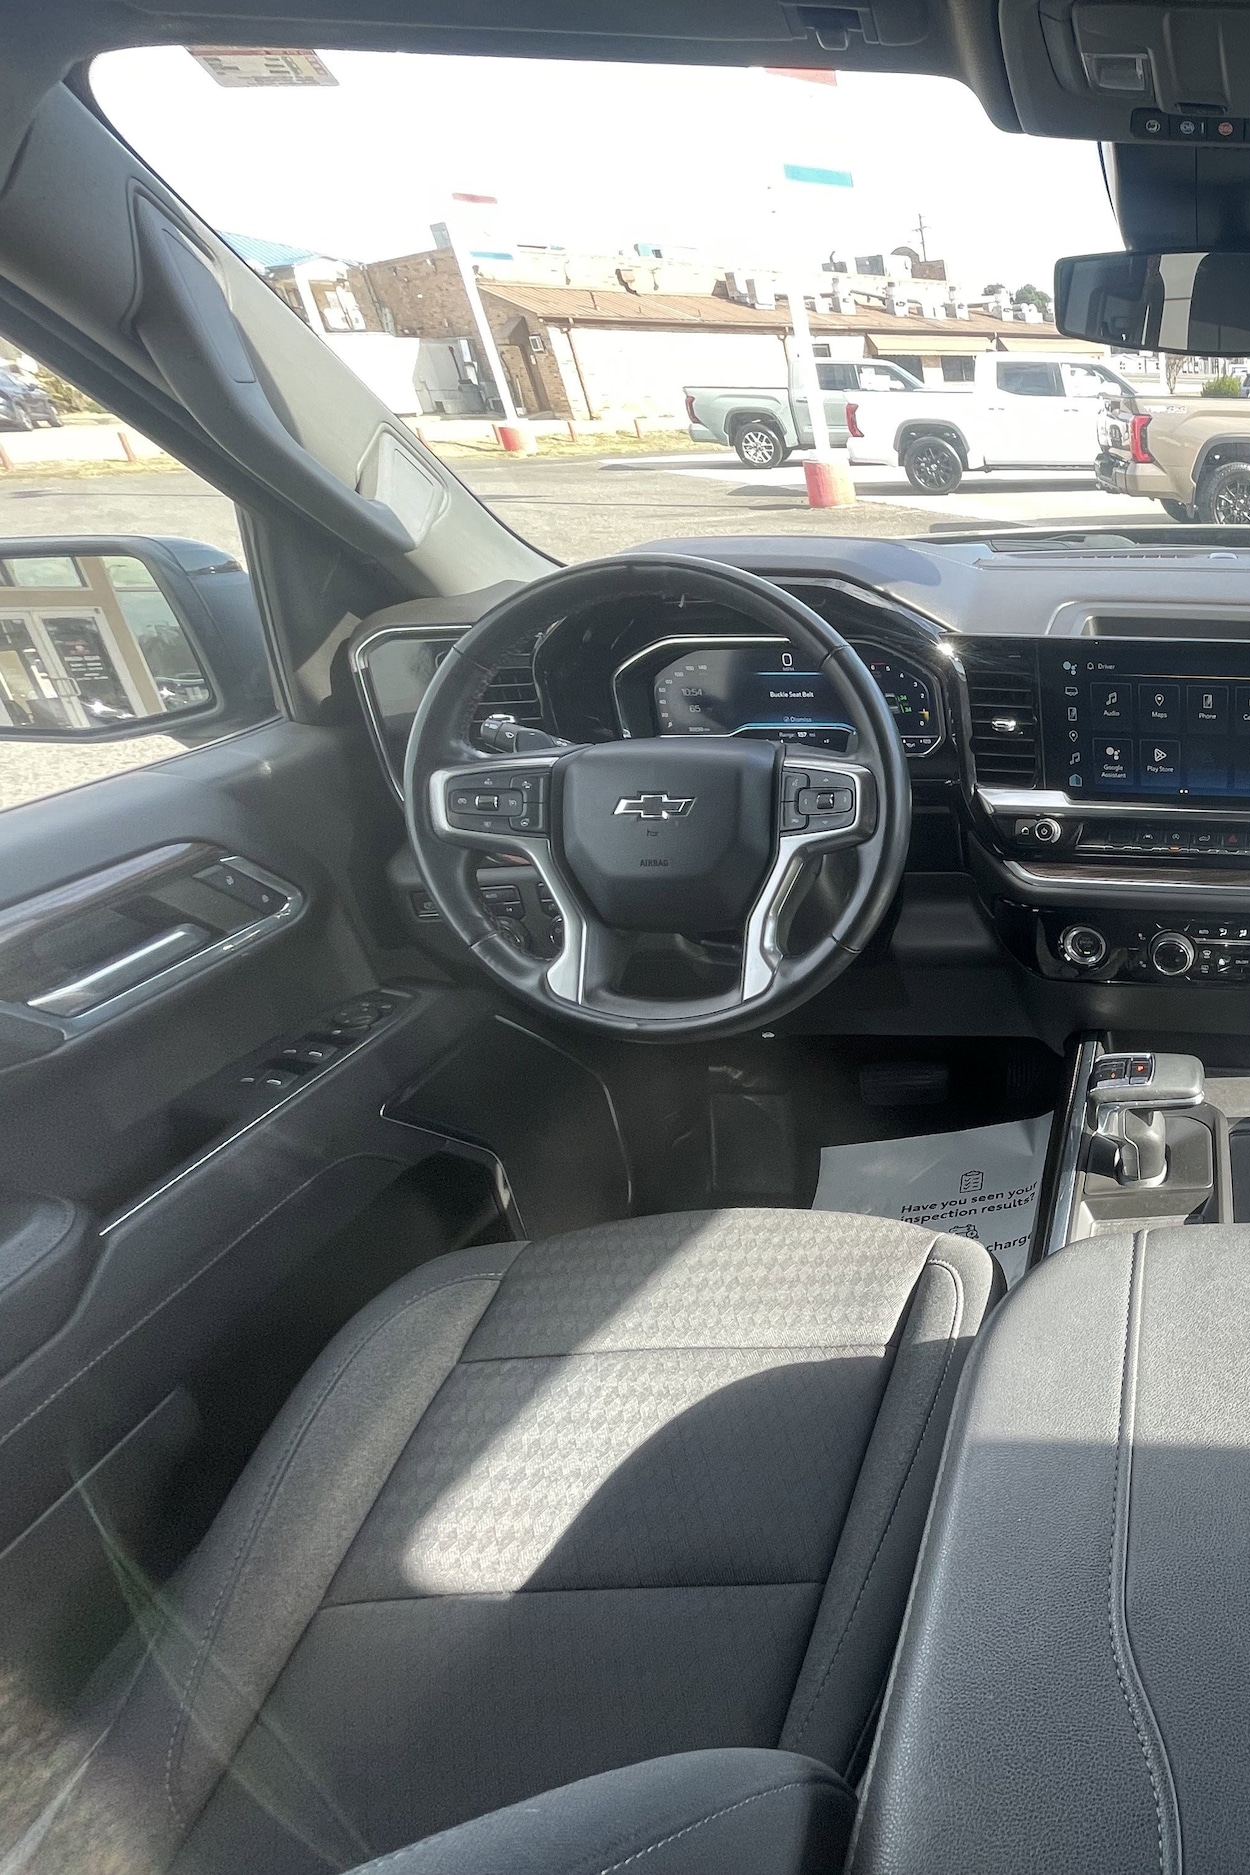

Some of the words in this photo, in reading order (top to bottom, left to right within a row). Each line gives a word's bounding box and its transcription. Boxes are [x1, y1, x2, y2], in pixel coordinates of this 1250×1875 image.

[782, 652, 792, 666] 0
[900, 1208, 977, 1224] inspection
[981, 1192, 1036, 1213] results?
[901, 1203, 937, 1214] Have
[941, 1198, 967, 1210] you
[971, 1192, 1004, 1203] seen
[1008, 1181, 1038, 1199] your
[986, 1233, 1032, 1252] charg
